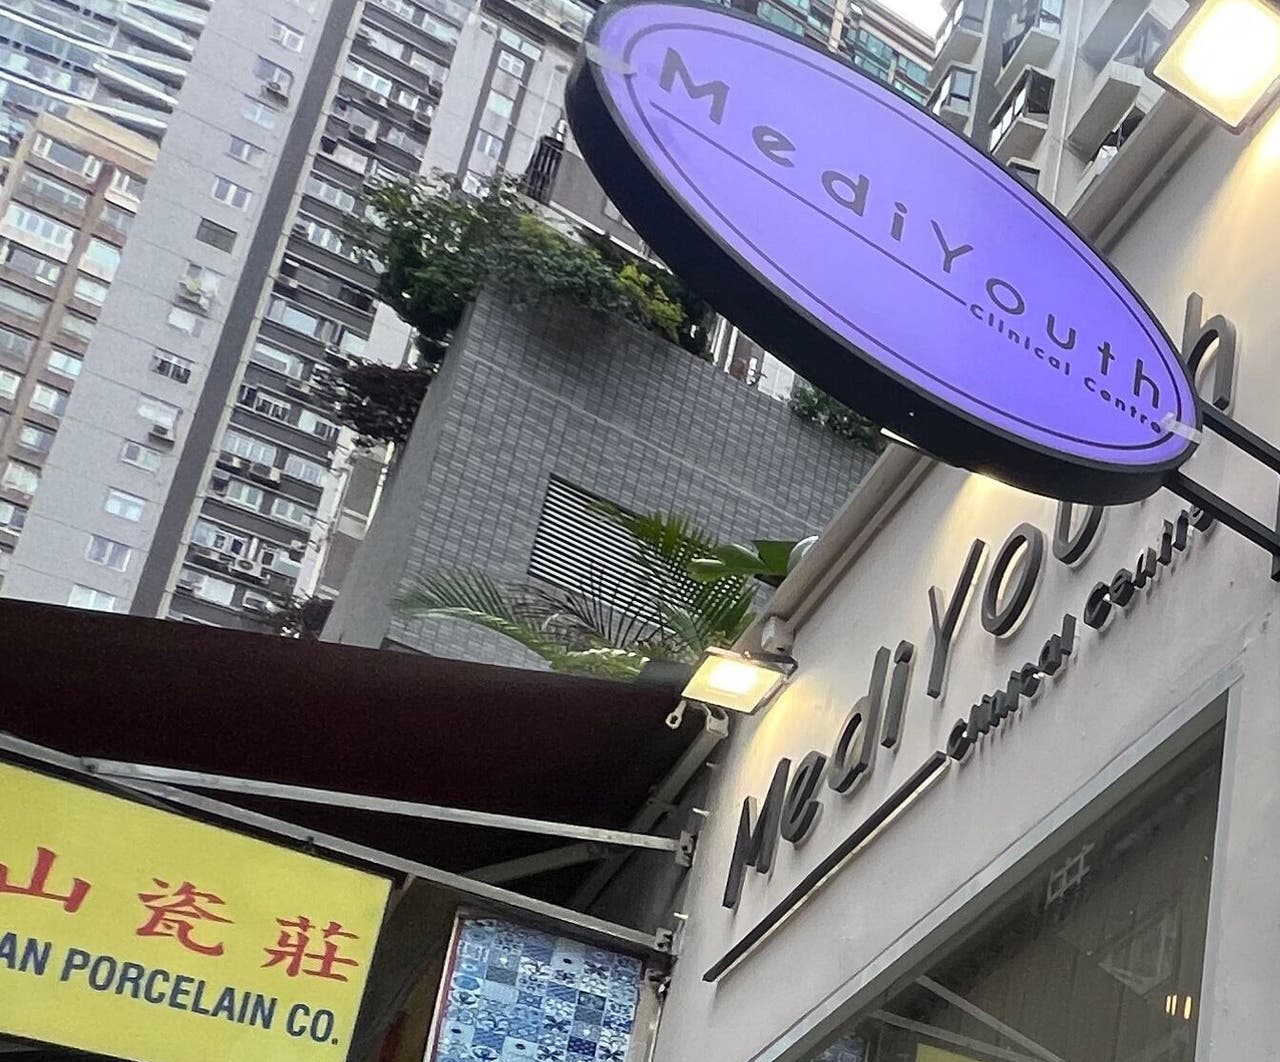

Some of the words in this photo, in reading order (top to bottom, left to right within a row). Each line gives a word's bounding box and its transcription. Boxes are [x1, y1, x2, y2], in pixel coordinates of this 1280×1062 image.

[658, 47, 1160, 410] MediYouth
[968, 302, 1072, 375] Clinical
[1083, 376, 1164, 434] Centre
[0, 847, 360, 983] 山瓷莊
[61, 948, 277, 1030] PORCELAIN
[286, 1003, 339, 1045] CO.
